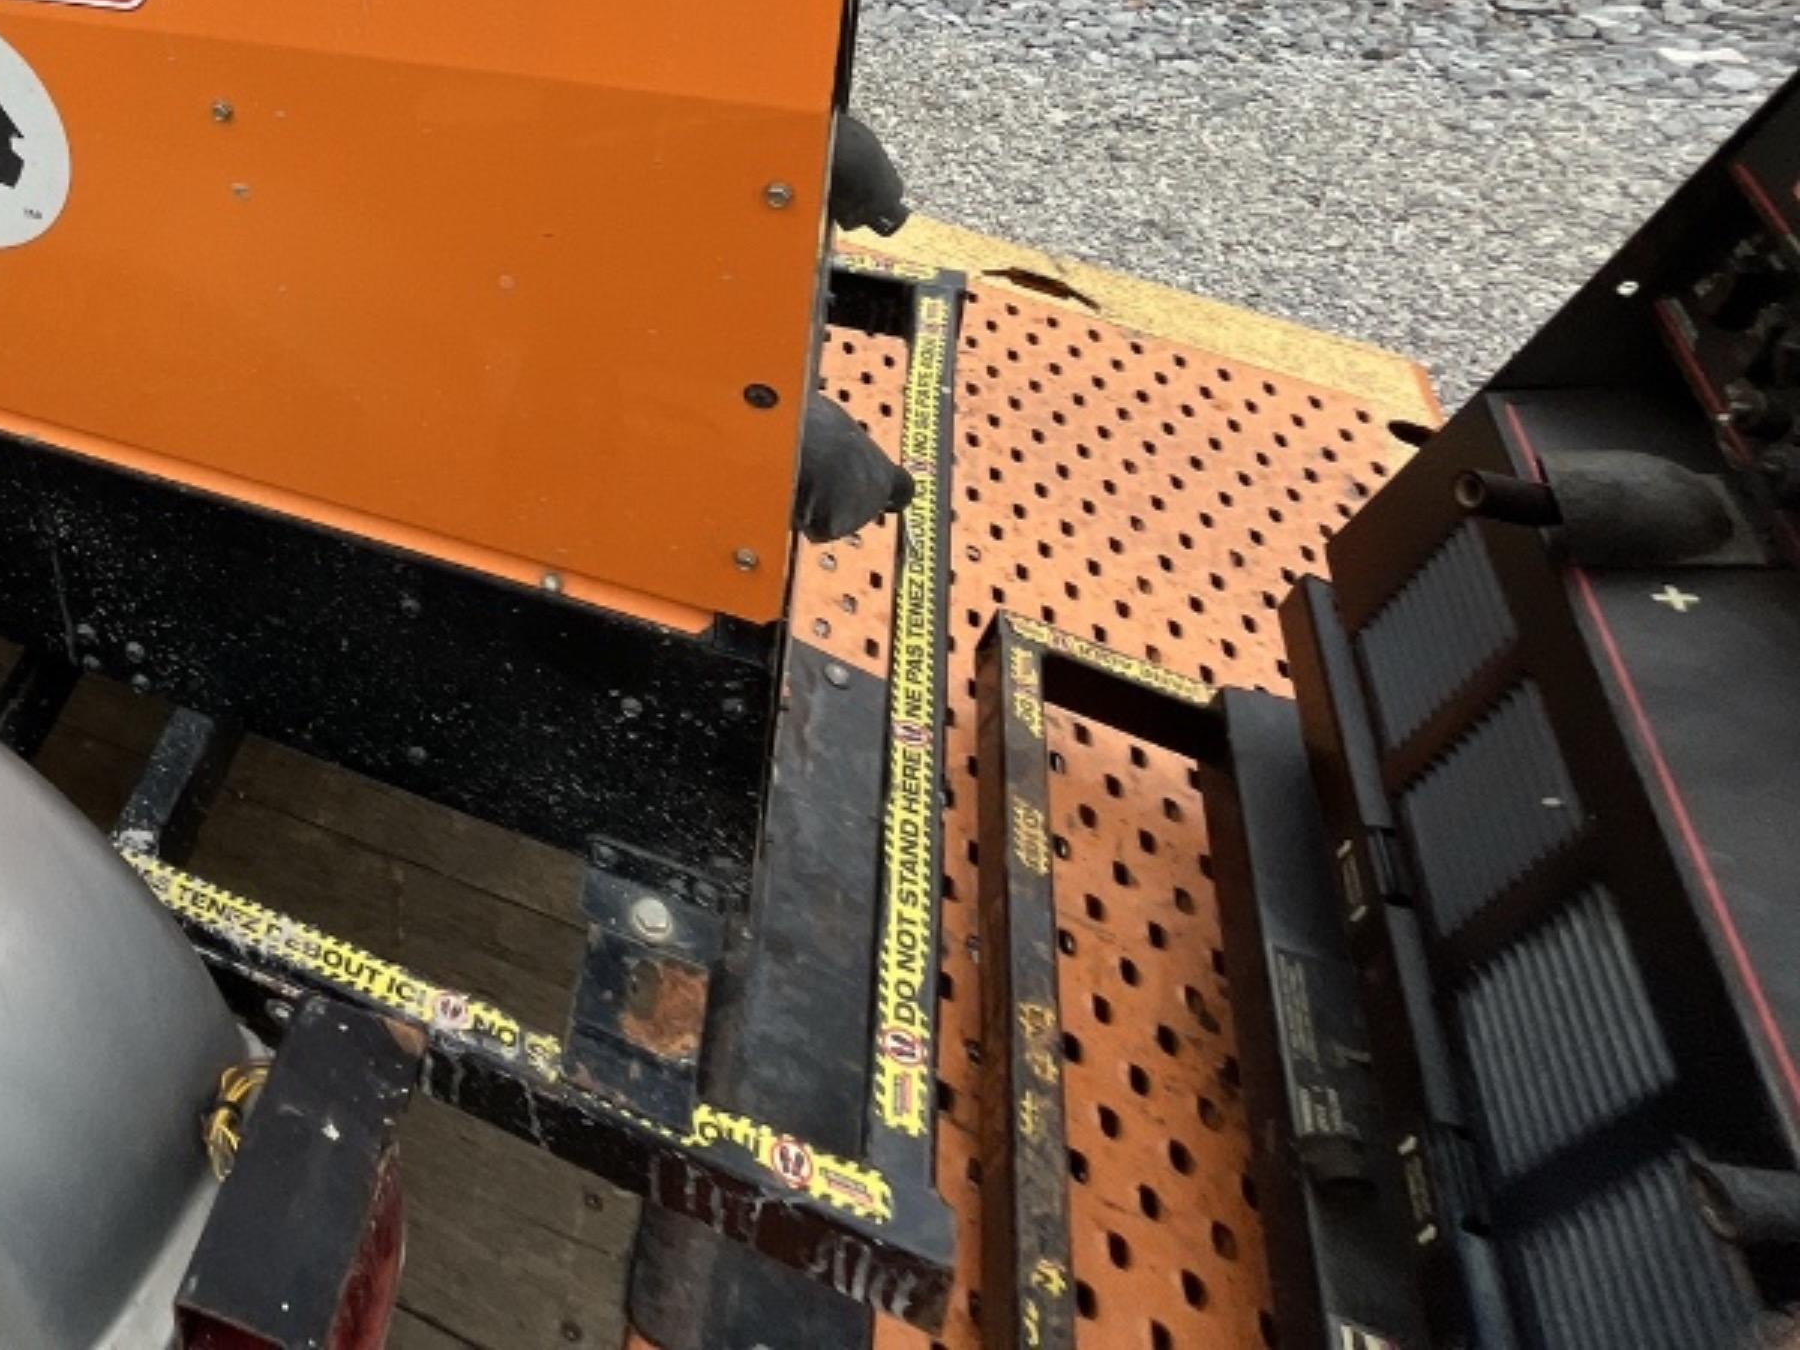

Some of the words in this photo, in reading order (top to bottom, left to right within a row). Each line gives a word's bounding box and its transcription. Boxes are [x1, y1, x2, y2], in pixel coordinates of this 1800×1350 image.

[904, 688, 923, 719] NE
[901, 746, 923, 815] HERE
[898, 817, 921, 909] STAND
[897, 910, 919, 976] NOT
[894, 978, 917, 1026] DO
